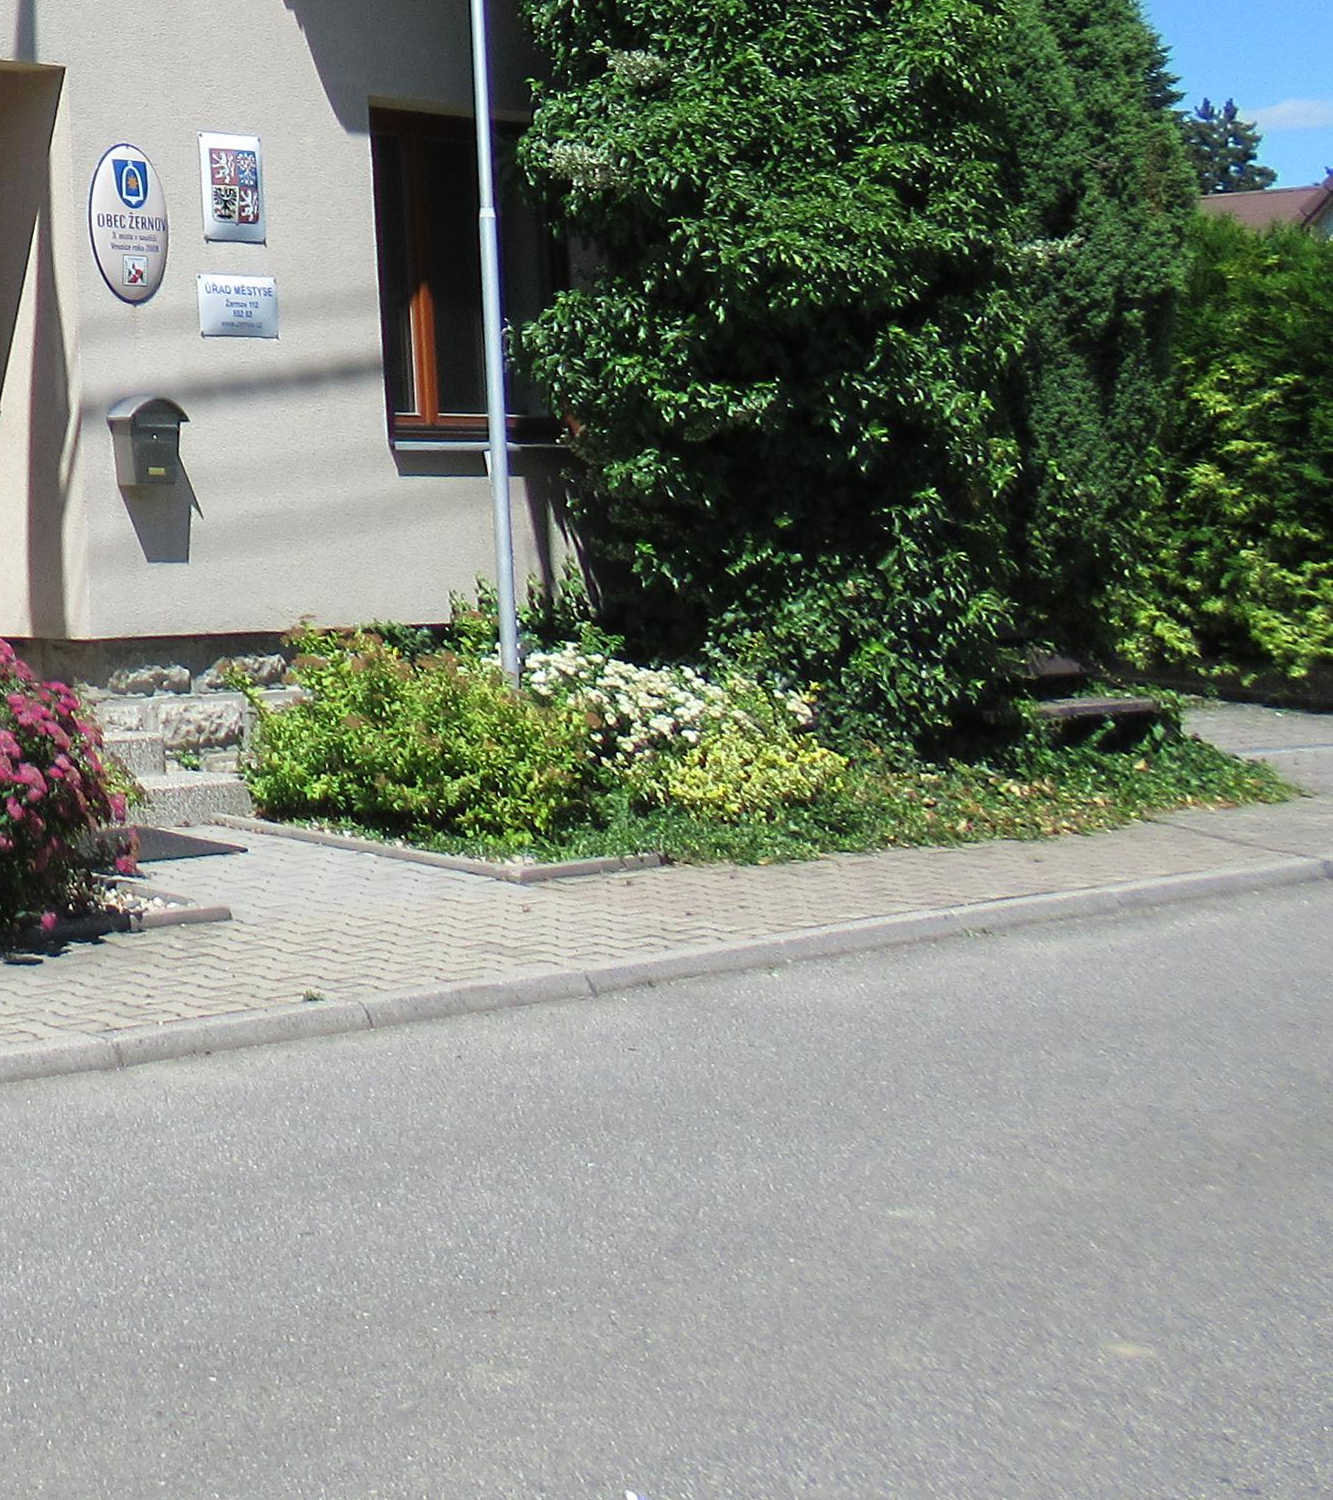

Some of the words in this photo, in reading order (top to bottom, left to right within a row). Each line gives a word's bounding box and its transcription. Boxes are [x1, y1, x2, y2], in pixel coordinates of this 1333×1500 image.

[97, 212, 126, 229] OBEC
[128, 212, 166, 231] ŽERNOV
[205, 282, 232, 295] ÚŘAD
[234, 283, 273, 297] MĚSTYSE
